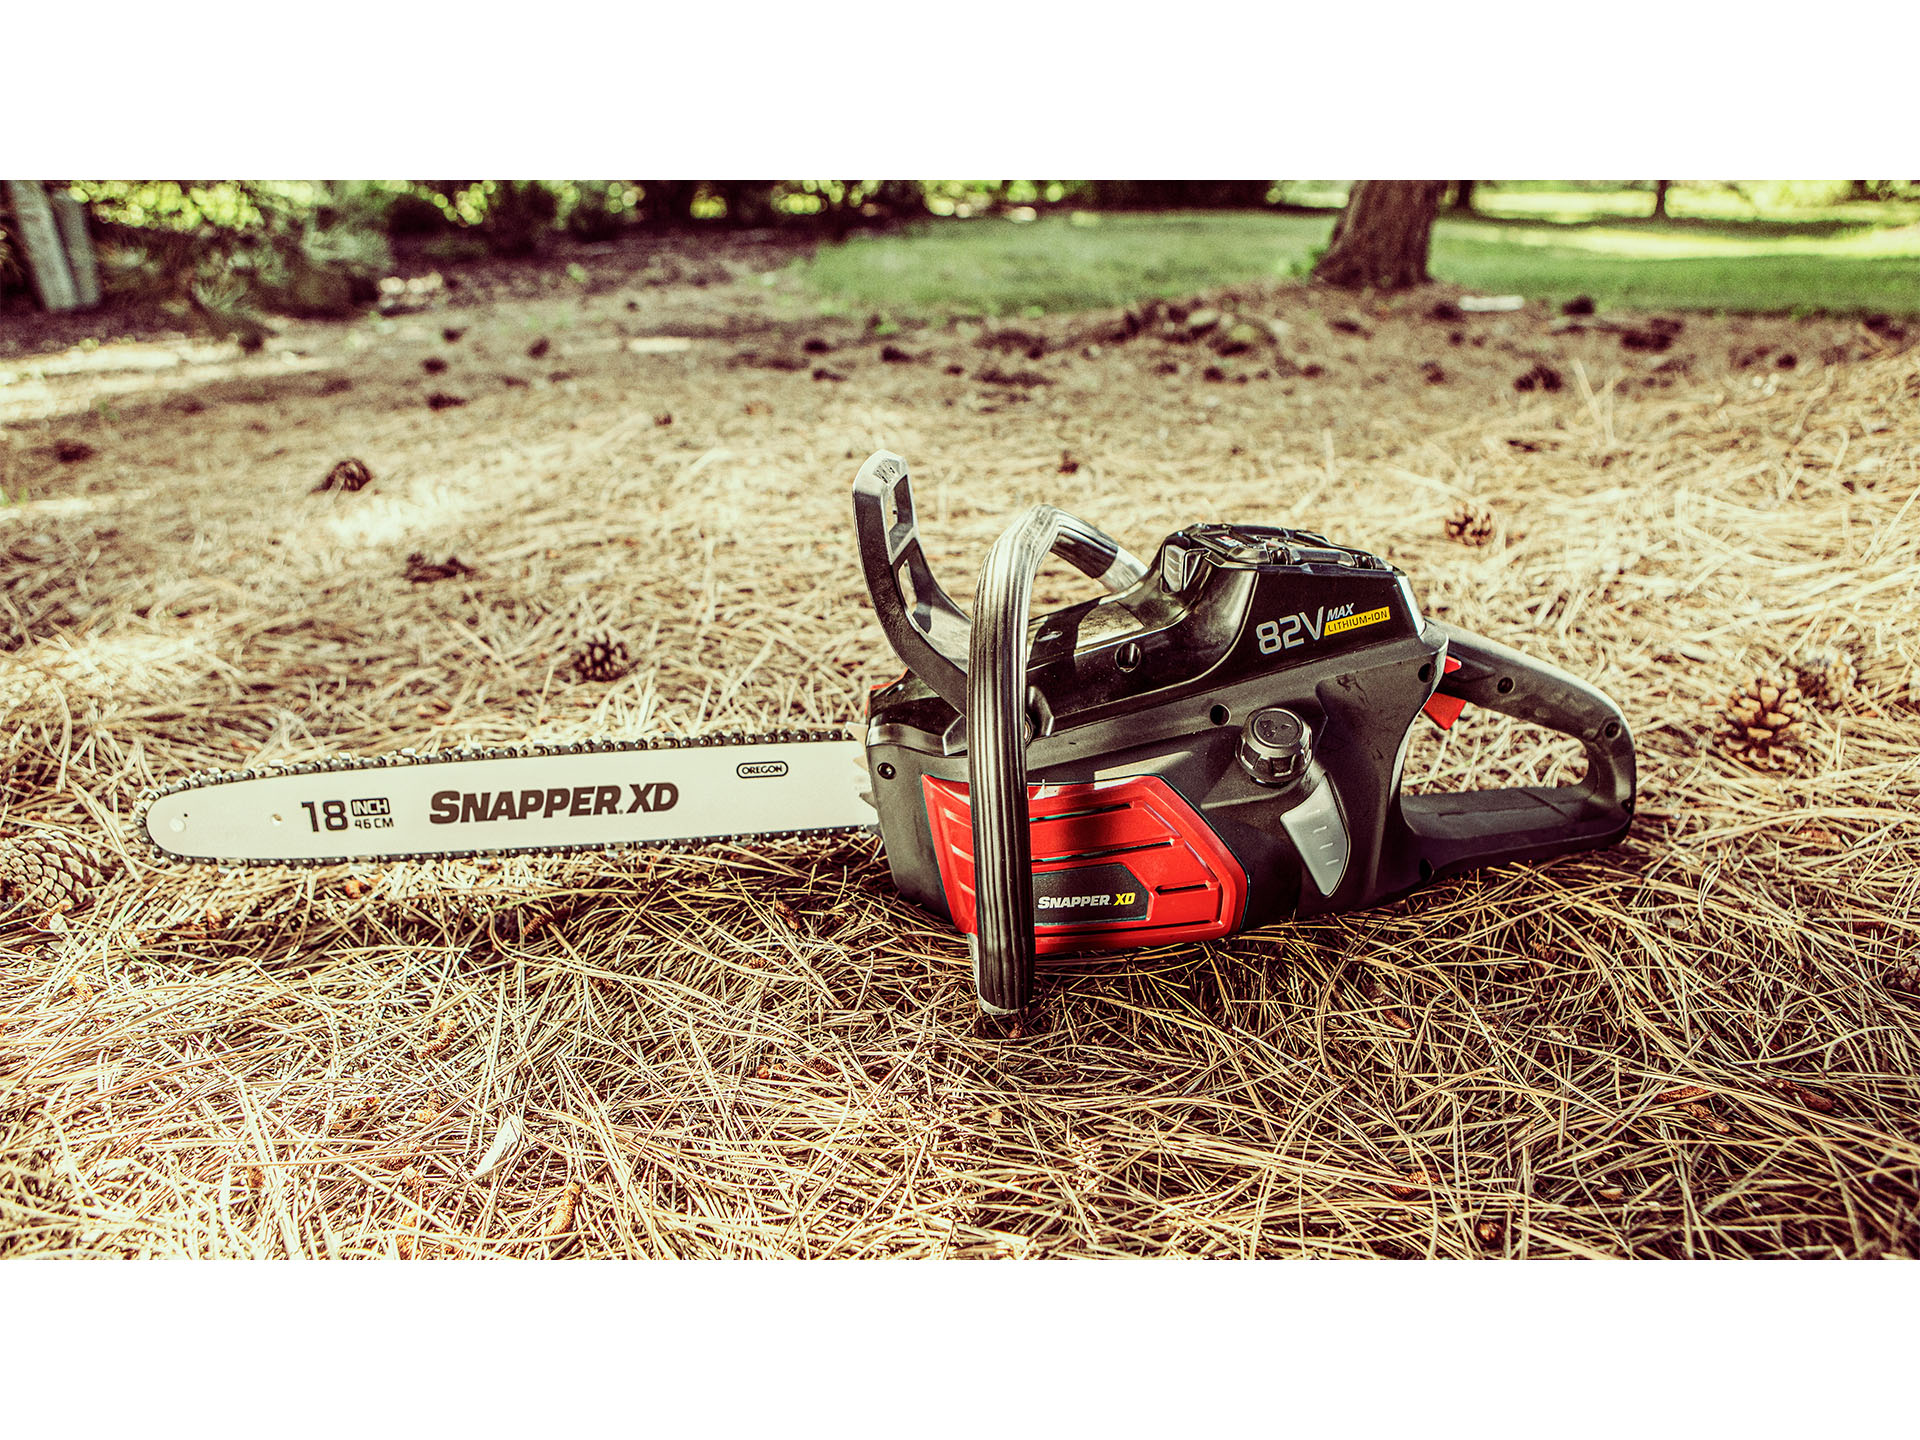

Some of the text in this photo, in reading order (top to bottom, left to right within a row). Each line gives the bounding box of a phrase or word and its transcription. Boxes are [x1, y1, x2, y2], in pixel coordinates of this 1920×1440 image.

[1256, 603, 1354, 655] 82V MAX
[1327, 610, 1388, 632] LITHIUM-ION
[741, 764, 783, 775] OREGON
[429, 782, 679, 824] SNAPPER XD
[301, 798, 389, 832] 18 INCH
[354, 817, 394, 829] 46 CM
[1038, 892, 1136, 909] SNAPPER XD
